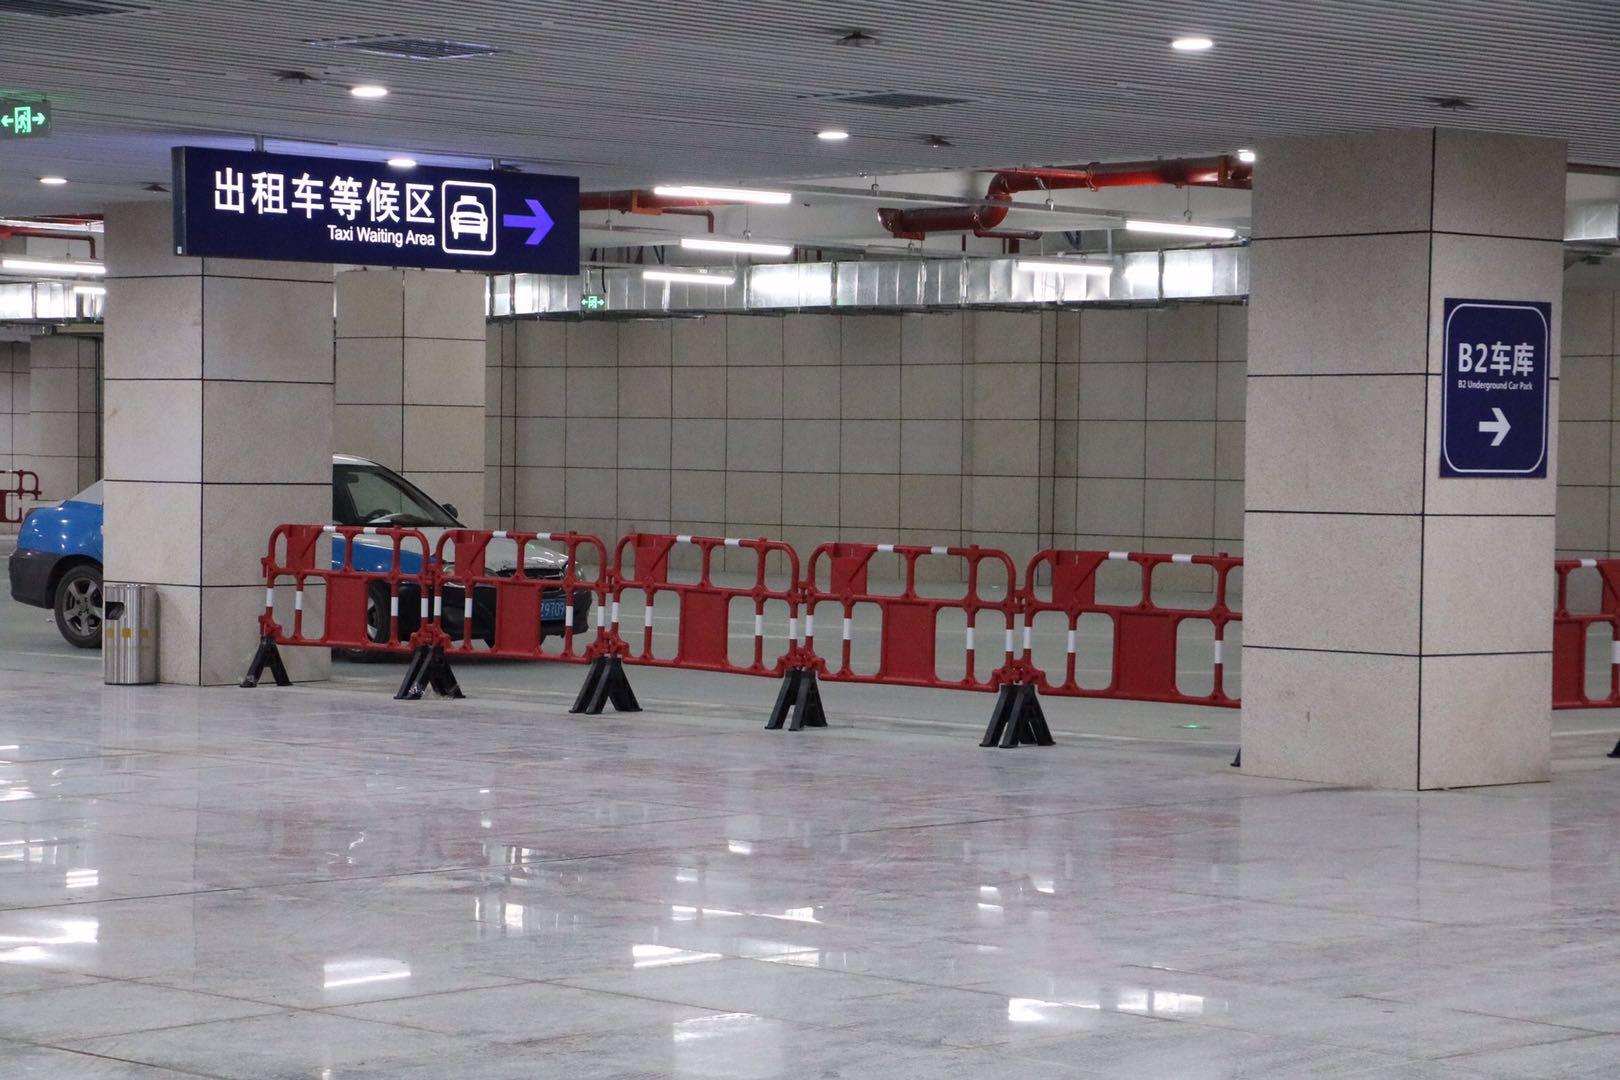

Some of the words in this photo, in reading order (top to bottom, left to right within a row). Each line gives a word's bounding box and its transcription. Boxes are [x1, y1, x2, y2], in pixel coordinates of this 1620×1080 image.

[214, 167, 436, 224] 出租车等候区
[327, 224, 354, 242] Taxi
[356, 226, 404, 248] Waiting
[405, 229, 436, 247] Area
[1458, 341, 1535, 377] B2车库
[1458, 379, 1467, 389] B2
[1467, 380, 1508, 392] Underground
[1508, 381, 1519, 390] Car
[1519, 381, 1533, 391] Park
